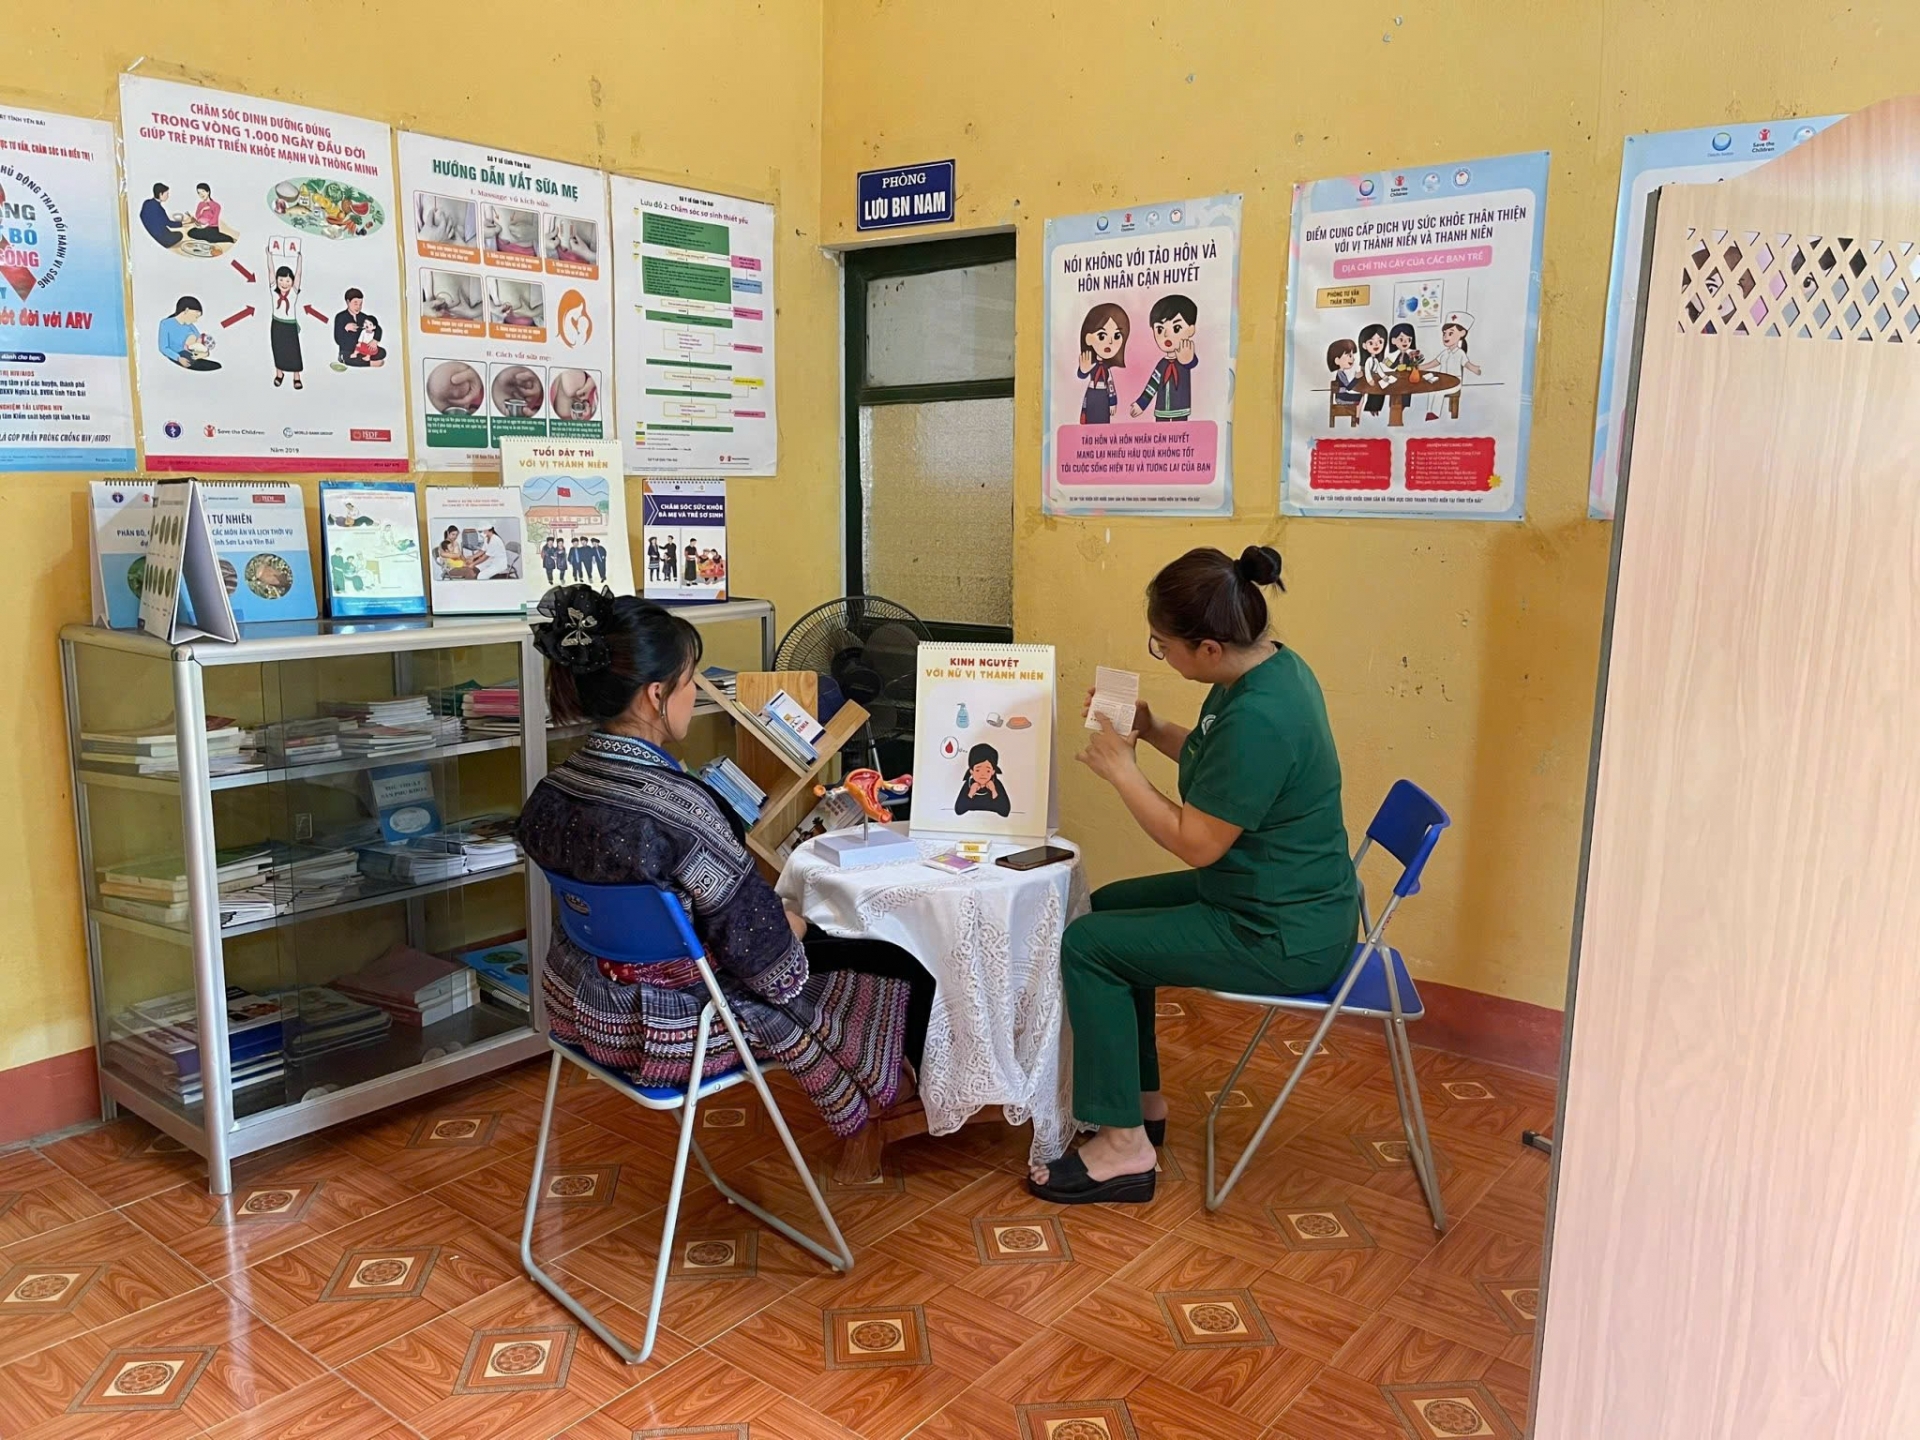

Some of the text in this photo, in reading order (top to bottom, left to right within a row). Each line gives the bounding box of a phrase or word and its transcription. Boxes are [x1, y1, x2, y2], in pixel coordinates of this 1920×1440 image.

[190, 103, 331, 138] CHĂM SÓC DINH DƯỠNG ĐÚNG
[152, 112, 366, 160] TRONG VÒNG 1.000 NGÀY ĐẦU ĐỜI
[140, 126, 378, 176] GIÚP TRẺ PHÁT TRIỂN KHỎE MẠNH VÀ THÔNG MINH
[433, 159, 578, 202] HƯỚNG DẪN VẮT SỮA MẸ
[882, 172, 926, 188] PHÒNG
[640, 199, 652, 207] Lưu
[654, 200, 662, 209] đồ
[671, 204, 688, 214] Chăm
[690, 206, 700, 216] sóc
[710, 211, 722, 220] sinh
[724, 213, 738, 222] thiết
[738, 216, 748, 224] yếu
[864, 191, 946, 220] LƯU BN NAM
[0, 165, 68, 288] HỦ ĐỘNG THAY ĐỔI HÀNH VI SỐNG
[9, 223, 37, 245] BỎ
[1306, 205, 1526, 242] ĐIỂM CUNG CẤP DỊCH VỤ SỨC KHỎE THÂN THIỆN
[273, 241, 297, 252] A A
[1334, 224, 1493, 254] VỚI VỊ THÀNH NIÊN VÀ THANH NIÊN
[1064, 239, 1216, 274] NÓI KHÔNG VỚI TẢO HÔN VÀ
[1342, 264, 1356, 274] ĐỊA
[1357, 262, 1372, 270] CHỈ
[1374, 261, 1387, 269] TIN
[1388, 260, 1404, 270] CẬY
[1406, 257, 1425, 266] CỦA
[1426, 255, 1444, 265] CÁC
[1468, 252, 1484, 260] TRẺ
[1078, 262, 1200, 292] HÔN NHÂN CẬN HUYẾT
[0, 306, 92, 329] ốt đời với ARV
[1082, 436, 1093, 445] TẢO
[1094, 436, 1108, 444] HÔN
[1110, 436, 1118, 444] VÀ
[1119, 434, 1132, 444] HÔN
[1134, 434, 1152, 444] NHÂN
[1168, 432, 1190, 443] HUYẾT
[533, 446, 554, 456] TUỔI
[579, 448, 594, 457] THÌ
[1077, 450, 1094, 459] MANG
[1107, 448, 1126, 458] NHIỀU
[1142, 447, 1156, 458] QUẢ
[1158, 447, 1180, 458] KHÔNG
[1182, 447, 1194, 458] TỐT
[520, 458, 608, 468] VỚI VỊ THÀNH NIÊN
[1062, 462, 1071, 472] TỚI
[1072, 463, 1090, 473] CUỘC
[1091, 462, 1108, 472] SỐNG
[1109, 462, 1124, 472] HIỆN
[1136, 462, 1144, 472] VÀ
[1146, 463, 1168, 472] TƯƠNG
[1170, 464, 1180, 472] LAI
[1182, 461, 1195, 472] CỦA
[1197, 463, 1210, 472] BẠN
[212, 514, 252, 526] TỰ NHIÊN
[212, 528, 293, 537] CÁC MÓN ĂN VÀ LỊCH THỜI VỤ
[926, 668, 1044, 680] VỚI NỮ VỊ THÀNH NIÊN
[950, 657, 1020, 670] KINH NGUYỆT
